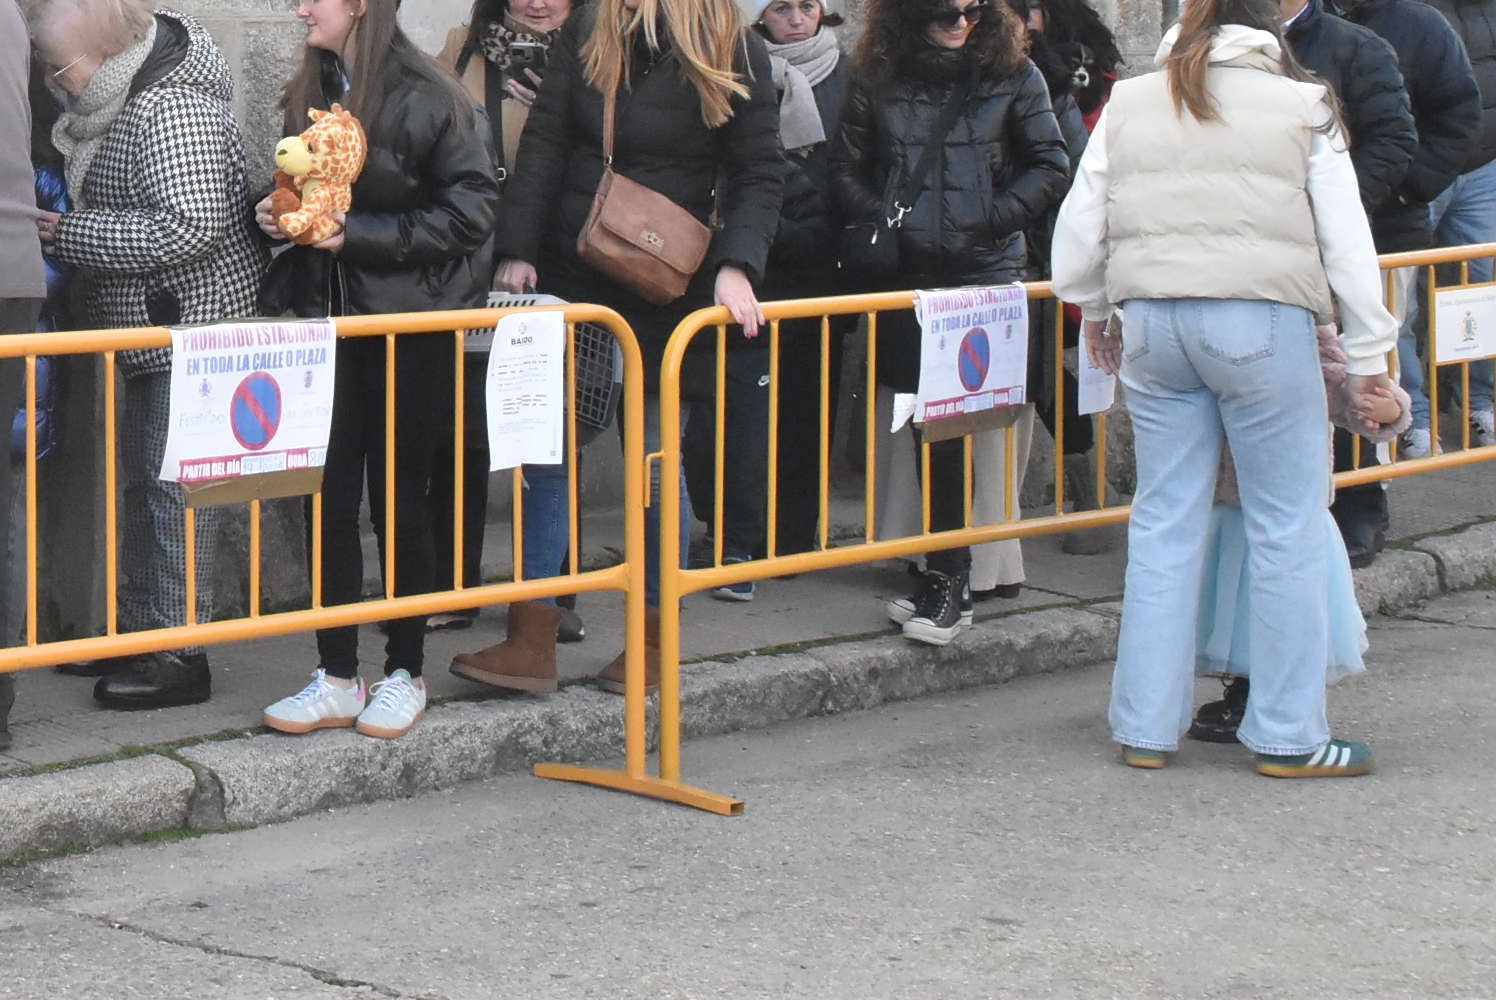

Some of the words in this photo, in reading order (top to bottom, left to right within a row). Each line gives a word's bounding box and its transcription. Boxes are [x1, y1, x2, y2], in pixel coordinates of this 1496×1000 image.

[183, 327, 253, 352] PROHIBIDO
[187, 358, 200, 376] EN
[203, 355, 234, 374] TODA
[236, 353, 250, 372] LA
[254, 351, 283, 370] CALLE
[286, 350, 293, 367] O
[296, 348, 326, 365] PLAZA
[212, 461, 226, 476] DEL
